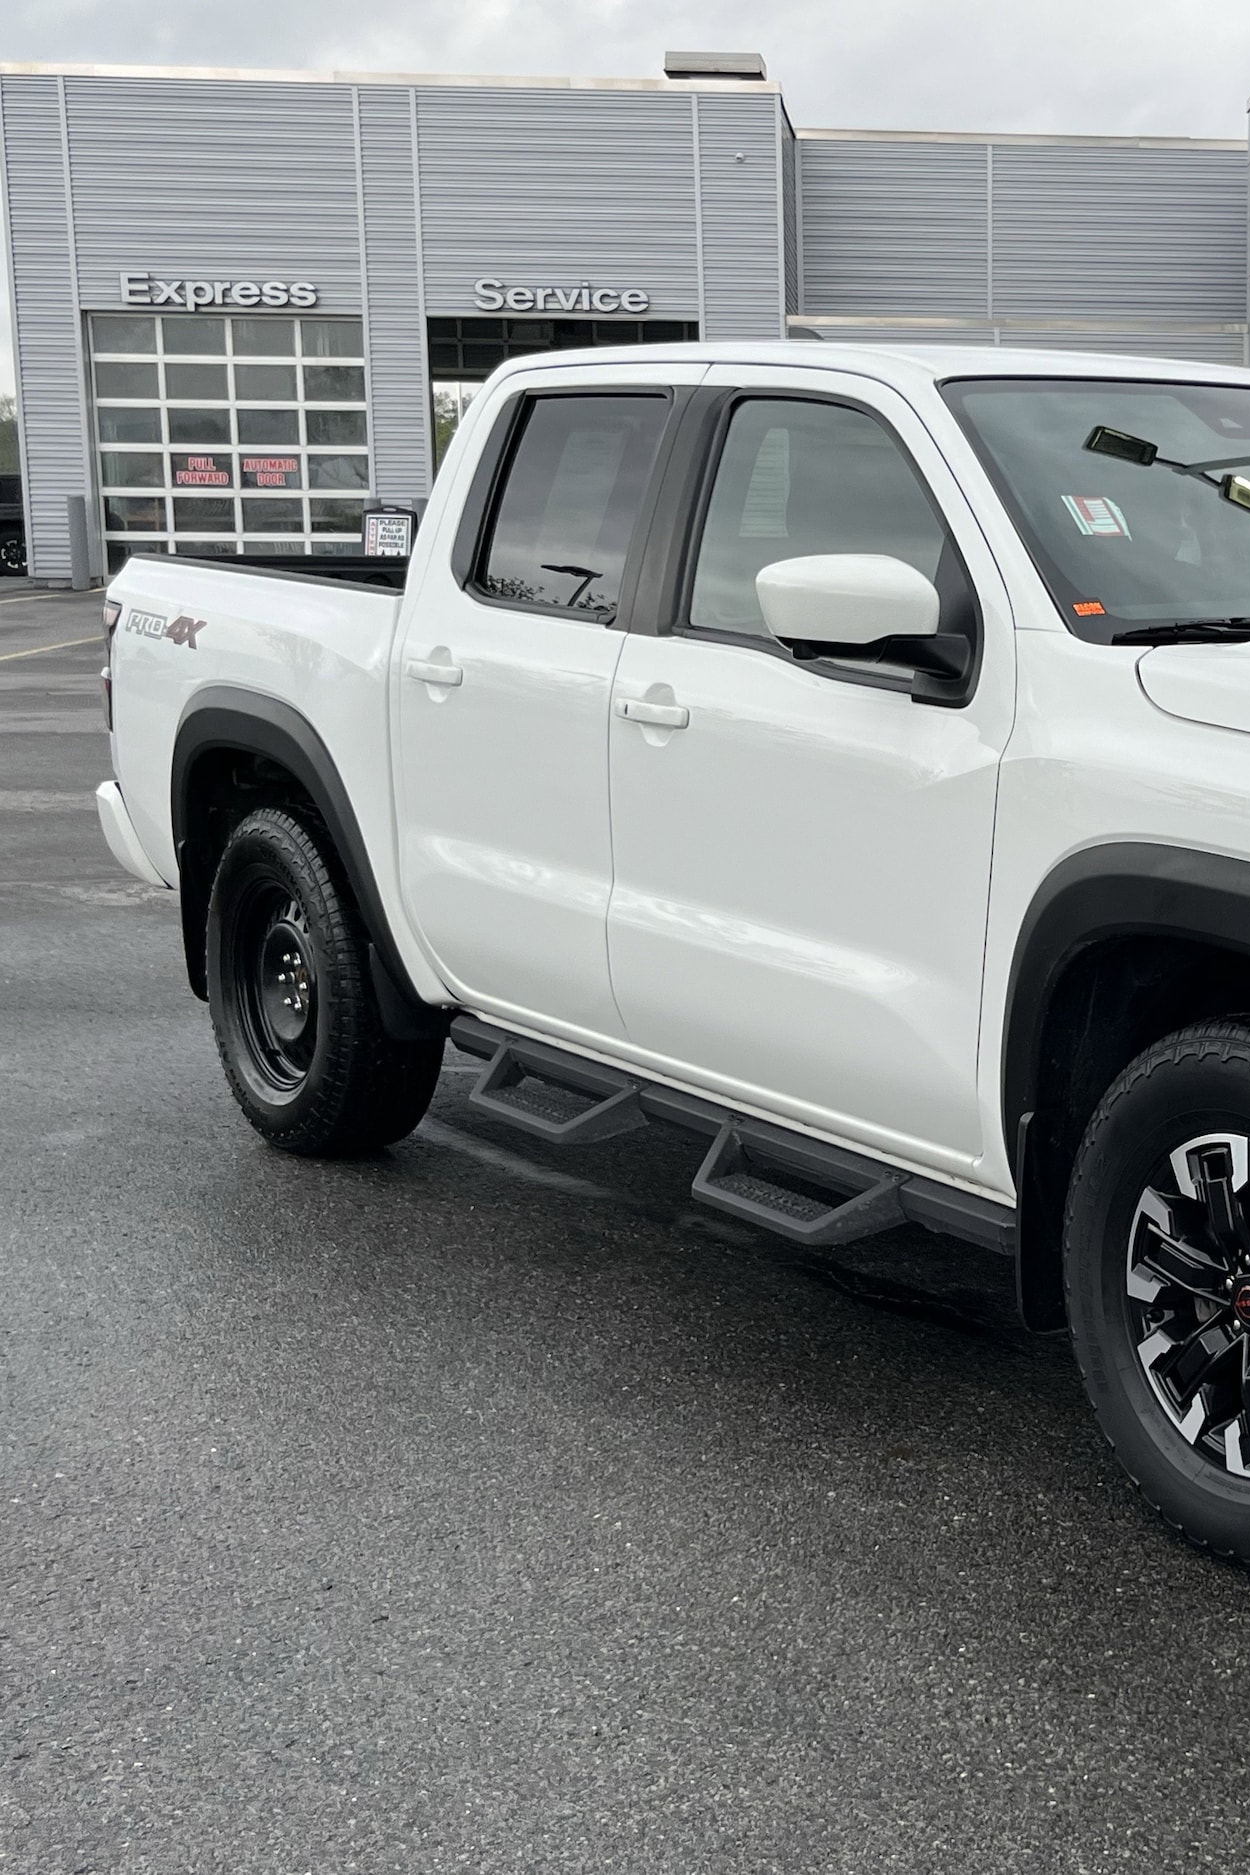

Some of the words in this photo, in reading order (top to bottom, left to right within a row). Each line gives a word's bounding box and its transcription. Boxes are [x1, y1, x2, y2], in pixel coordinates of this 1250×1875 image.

[120, 272, 318, 312] Express
[474, 278, 650, 313] Service
[188, 457, 216, 470] PULL
[243, 459, 297, 472] AUTOMATIC
[176, 471, 229, 485] FORWARD
[257, 473, 286, 486] DOOR
